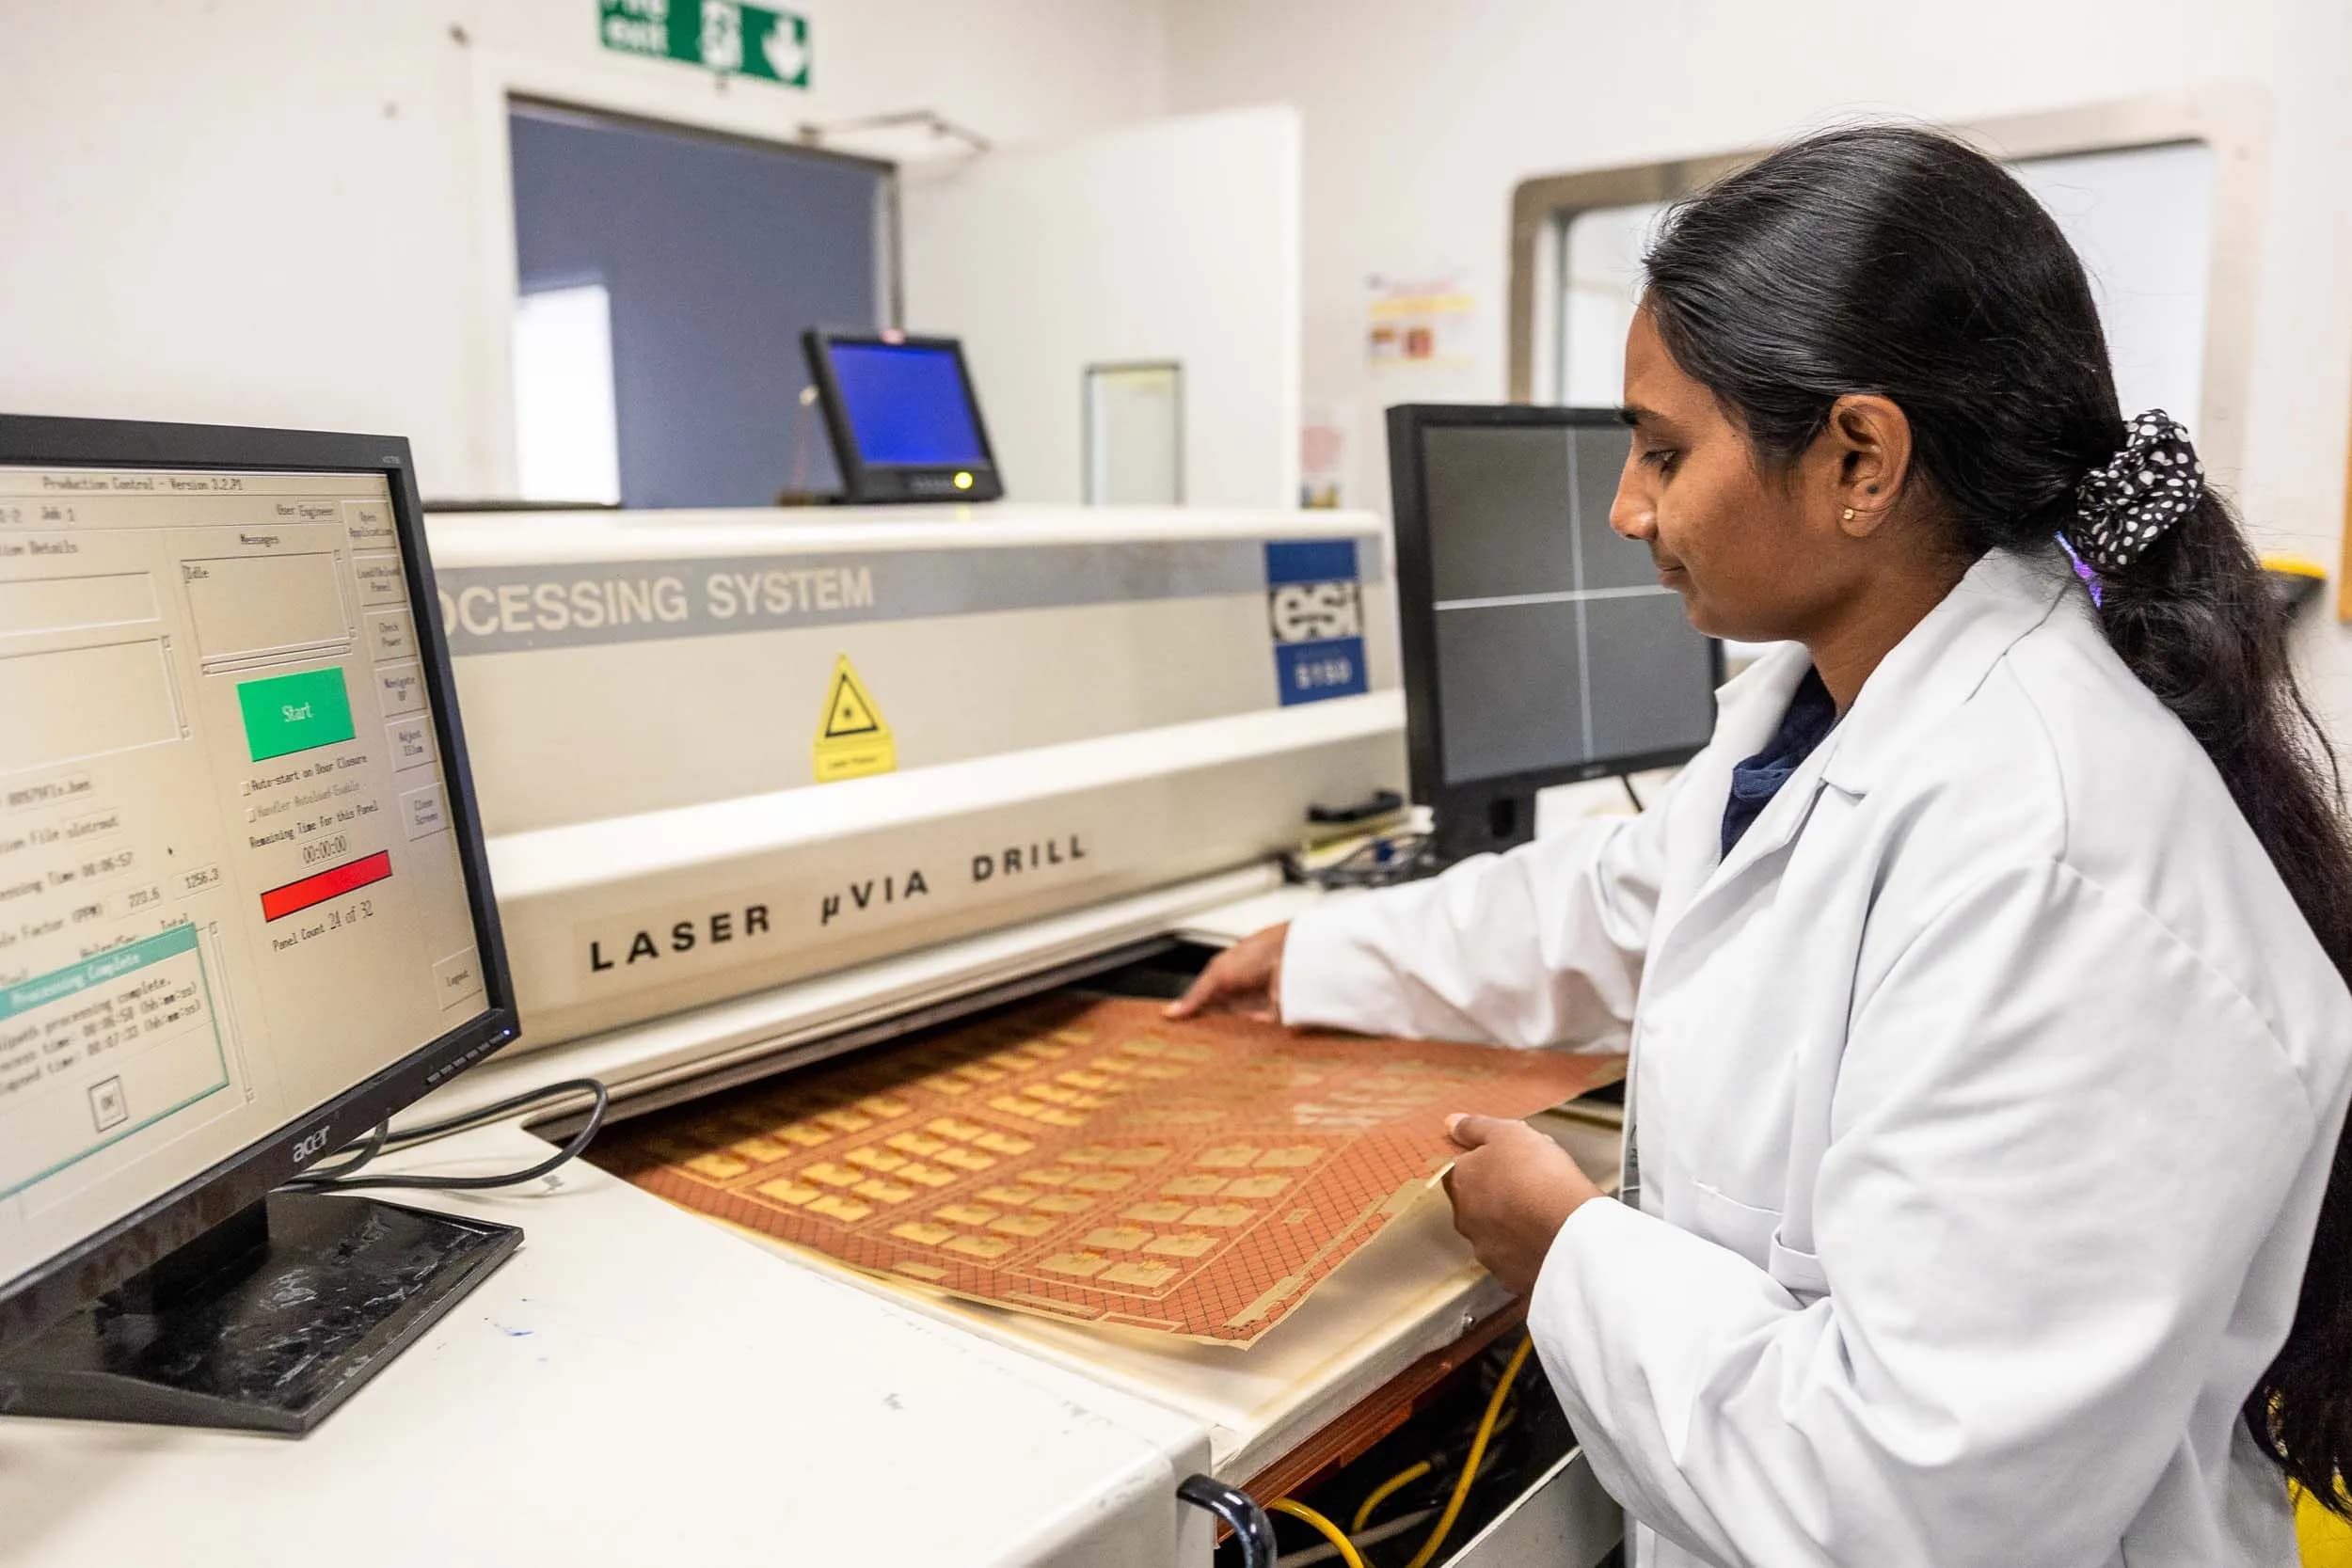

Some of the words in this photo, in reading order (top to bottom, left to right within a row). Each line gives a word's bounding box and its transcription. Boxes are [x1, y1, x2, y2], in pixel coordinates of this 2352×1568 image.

[43, 476, 108, 490] Production
[112, 476, 154, 490] Control
[169, 478, 209, 490] Version
[277, 504, 295, 515] User
[298, 505, 334, 519] Engineer
[29, 541, 78, 555] Details
[240, 533, 279, 547] Messages
[707, 566, 873, 619] SYSTEM
[1274, 583, 1360, 643] esi
[378, 622, 400, 633] Check
[281, 702, 313, 722] Start
[251, 771, 300, 791] Auto-start
[302, 768, 313, 779] on
[315, 763, 334, 775] Door
[336, 755, 368, 769] Closure
[248, 828, 294, 849] Remaining
[296, 821, 317, 835] Time
[320, 815, 333, 828] for
[336, 809, 355, 823] this
[357, 800, 379, 816] Panel
[415, 813, 438, 826] Screen
[302, 834, 347, 863] 00:00:00
[48, 869, 75, 886] Time
[590, 904, 770, 973] LASER
[971, 833, 1087, 884] DRILL
[21, 920, 63, 940] Factor
[271, 932, 299, 952] Panel
[301, 923, 326, 940] Count
[345, 905, 358, 924] of
[359, 899, 374, 919] 32
[445, 969, 469, 988] Logout
[117, 978, 171, 1005] complete.
[293, 1125, 330, 1163] acer
